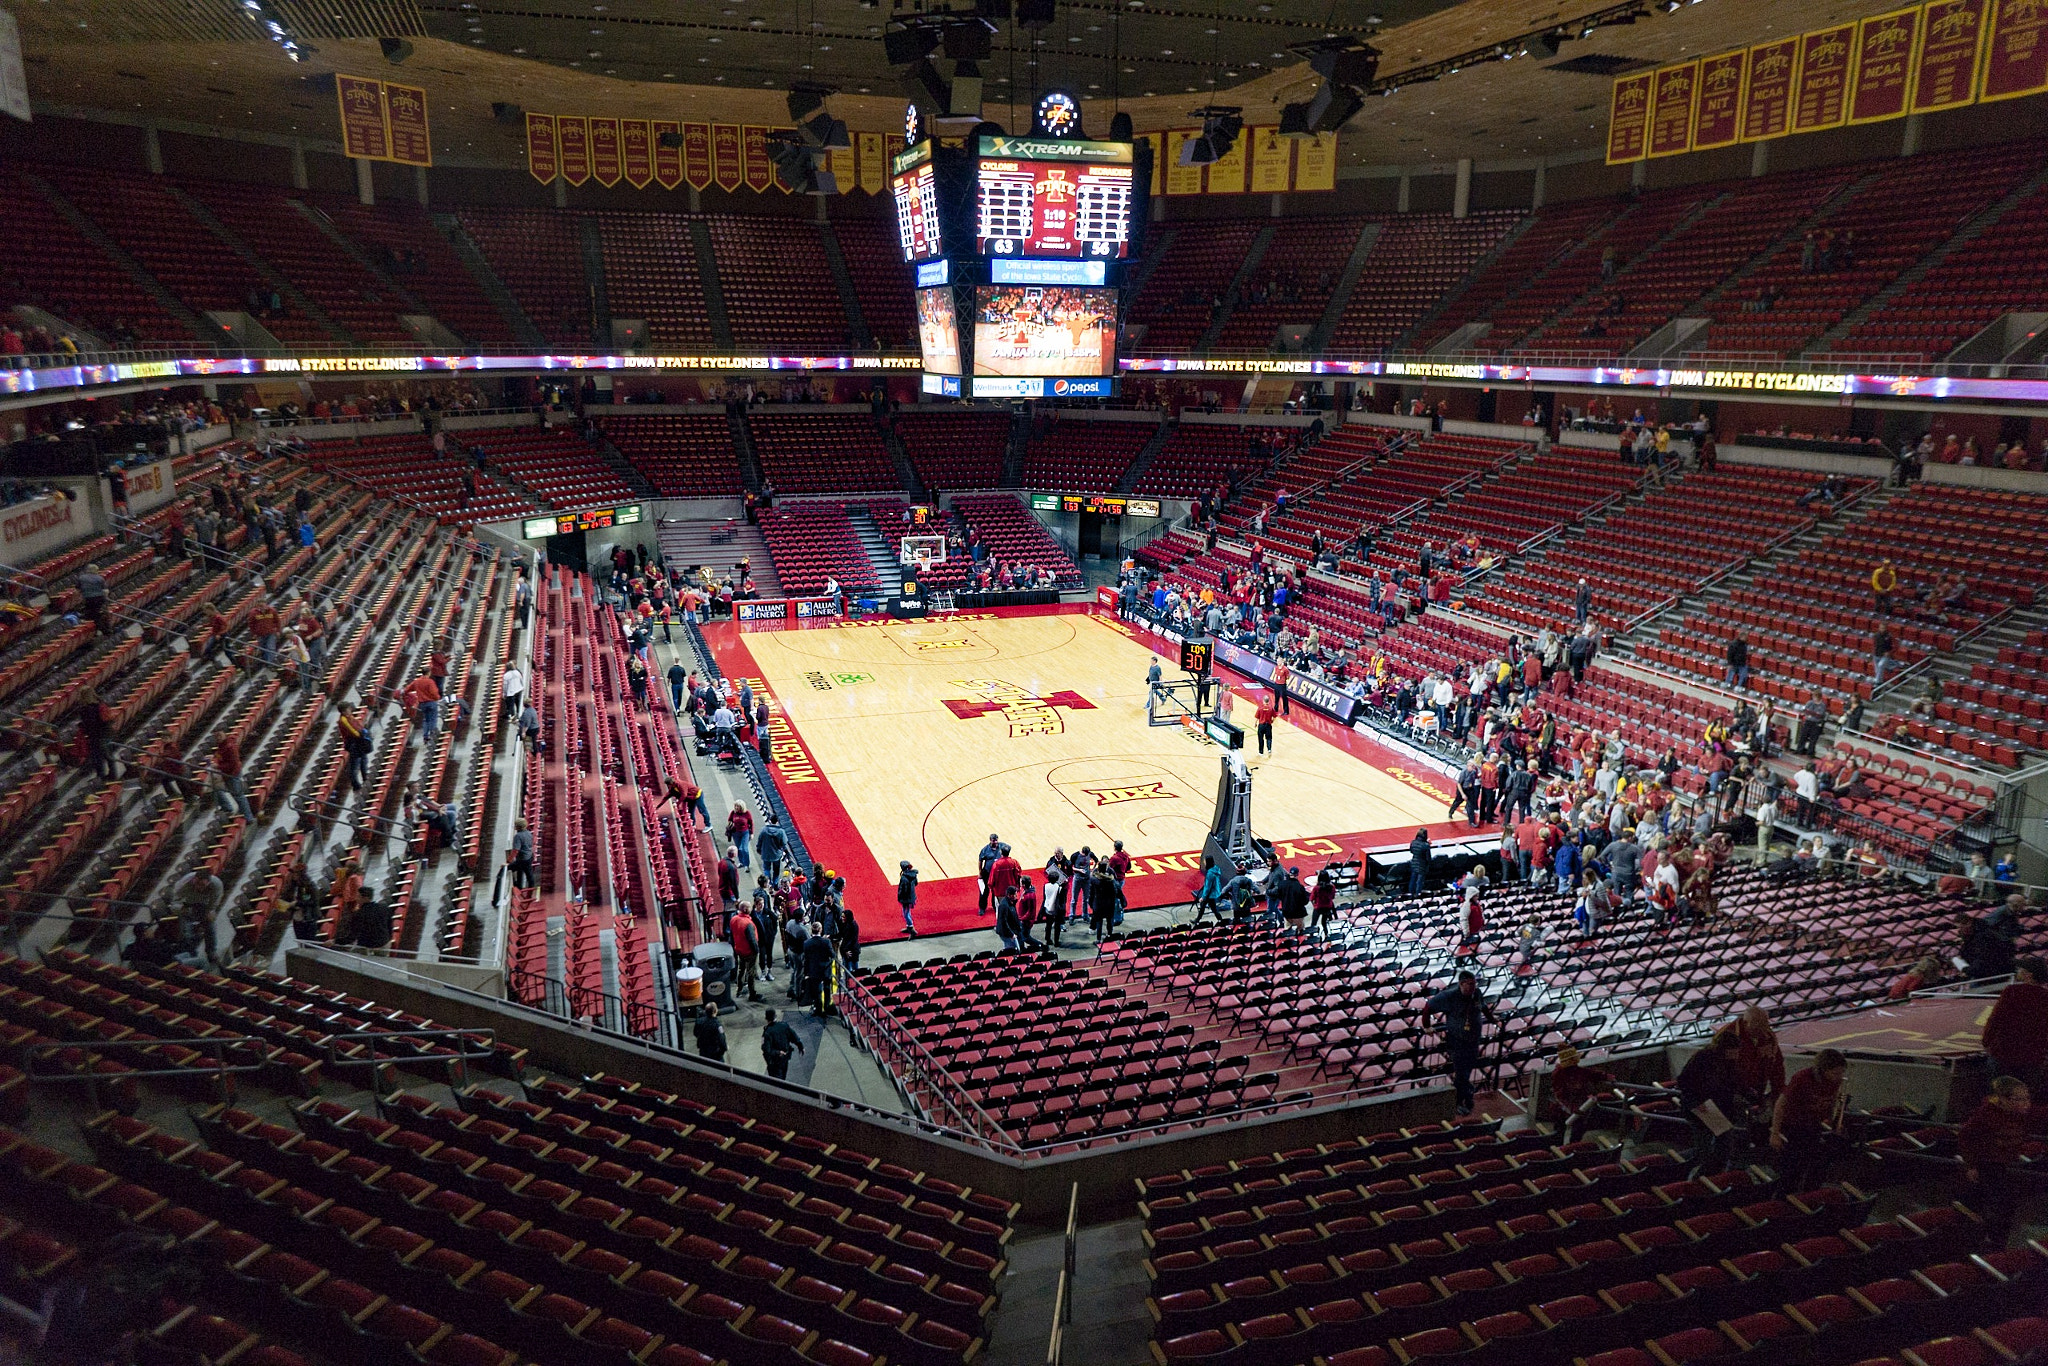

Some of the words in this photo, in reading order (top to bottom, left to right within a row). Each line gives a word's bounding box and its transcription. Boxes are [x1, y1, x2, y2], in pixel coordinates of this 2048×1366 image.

[1865, 62, 1901, 79] NCAA
[1806, 74, 1840, 90] NCAA
[1754, 86, 1784, 101] NCAA
[1708, 96, 1730, 111] NIT
[1015, 142, 1082, 158] XTREAM
[980, 162, 1018, 172] CYCLONES
[1215, 159, 1240, 167] NCAA
[1036, 180, 1076, 196] STATE
[995, 240, 1014, 253] 63
[1092, 242, 1110, 255] 56
[1005, 261, 1030, 270] Official
[1032, 262, 1060, 271] wireless
[1001, 272, 1010, 281] of
[1011, 272, 1023, 281] the
[1024, 273, 1041, 281] Iowa
[1042, 272, 1061, 281] State
[997, 321, 1045, 339] STATE
[266, 358, 299, 371] IOWA
[302, 358, 346, 371] STATE
[348, 358, 416, 371] CYCLONES
[624, 358, 656, 368] IOWA
[657, 357, 699, 368] STATE
[701, 357, 769, 369] CYCLONES
[854, 358, 881, 368] IOWA
[883, 358, 921, 368] STATE
[1176, 360, 1204, 371] IOWA
[1206, 361, 1244, 371] STATE
[1246, 361, 1312, 373] CYCLONES
[1387, 363, 1405, 374] IOWA
[1405, 363, 1432, 377] STATE
[1432, 364, 1480, 379] CYCLONES
[974, 382, 1013, 392] Wellmark
[1069, 381, 1100, 395] pepsi
[1671, 370, 1703, 386] IOWA
[1704, 371, 1754, 388] STATE
[1754, 371, 1845, 393] CYCLONES
[915, 514, 925, 523] 30
[827, 620, 906, 628] IOWA
[910, 614, 998, 622] STATE
[1191, 645, 1206, 655] 1:09
[1186, 653, 1203, 671] 30
[1298, 680, 1340, 712] STATE
[947, 679, 1065, 738] STATE
[768, 717, 820, 784] COLISEUM
